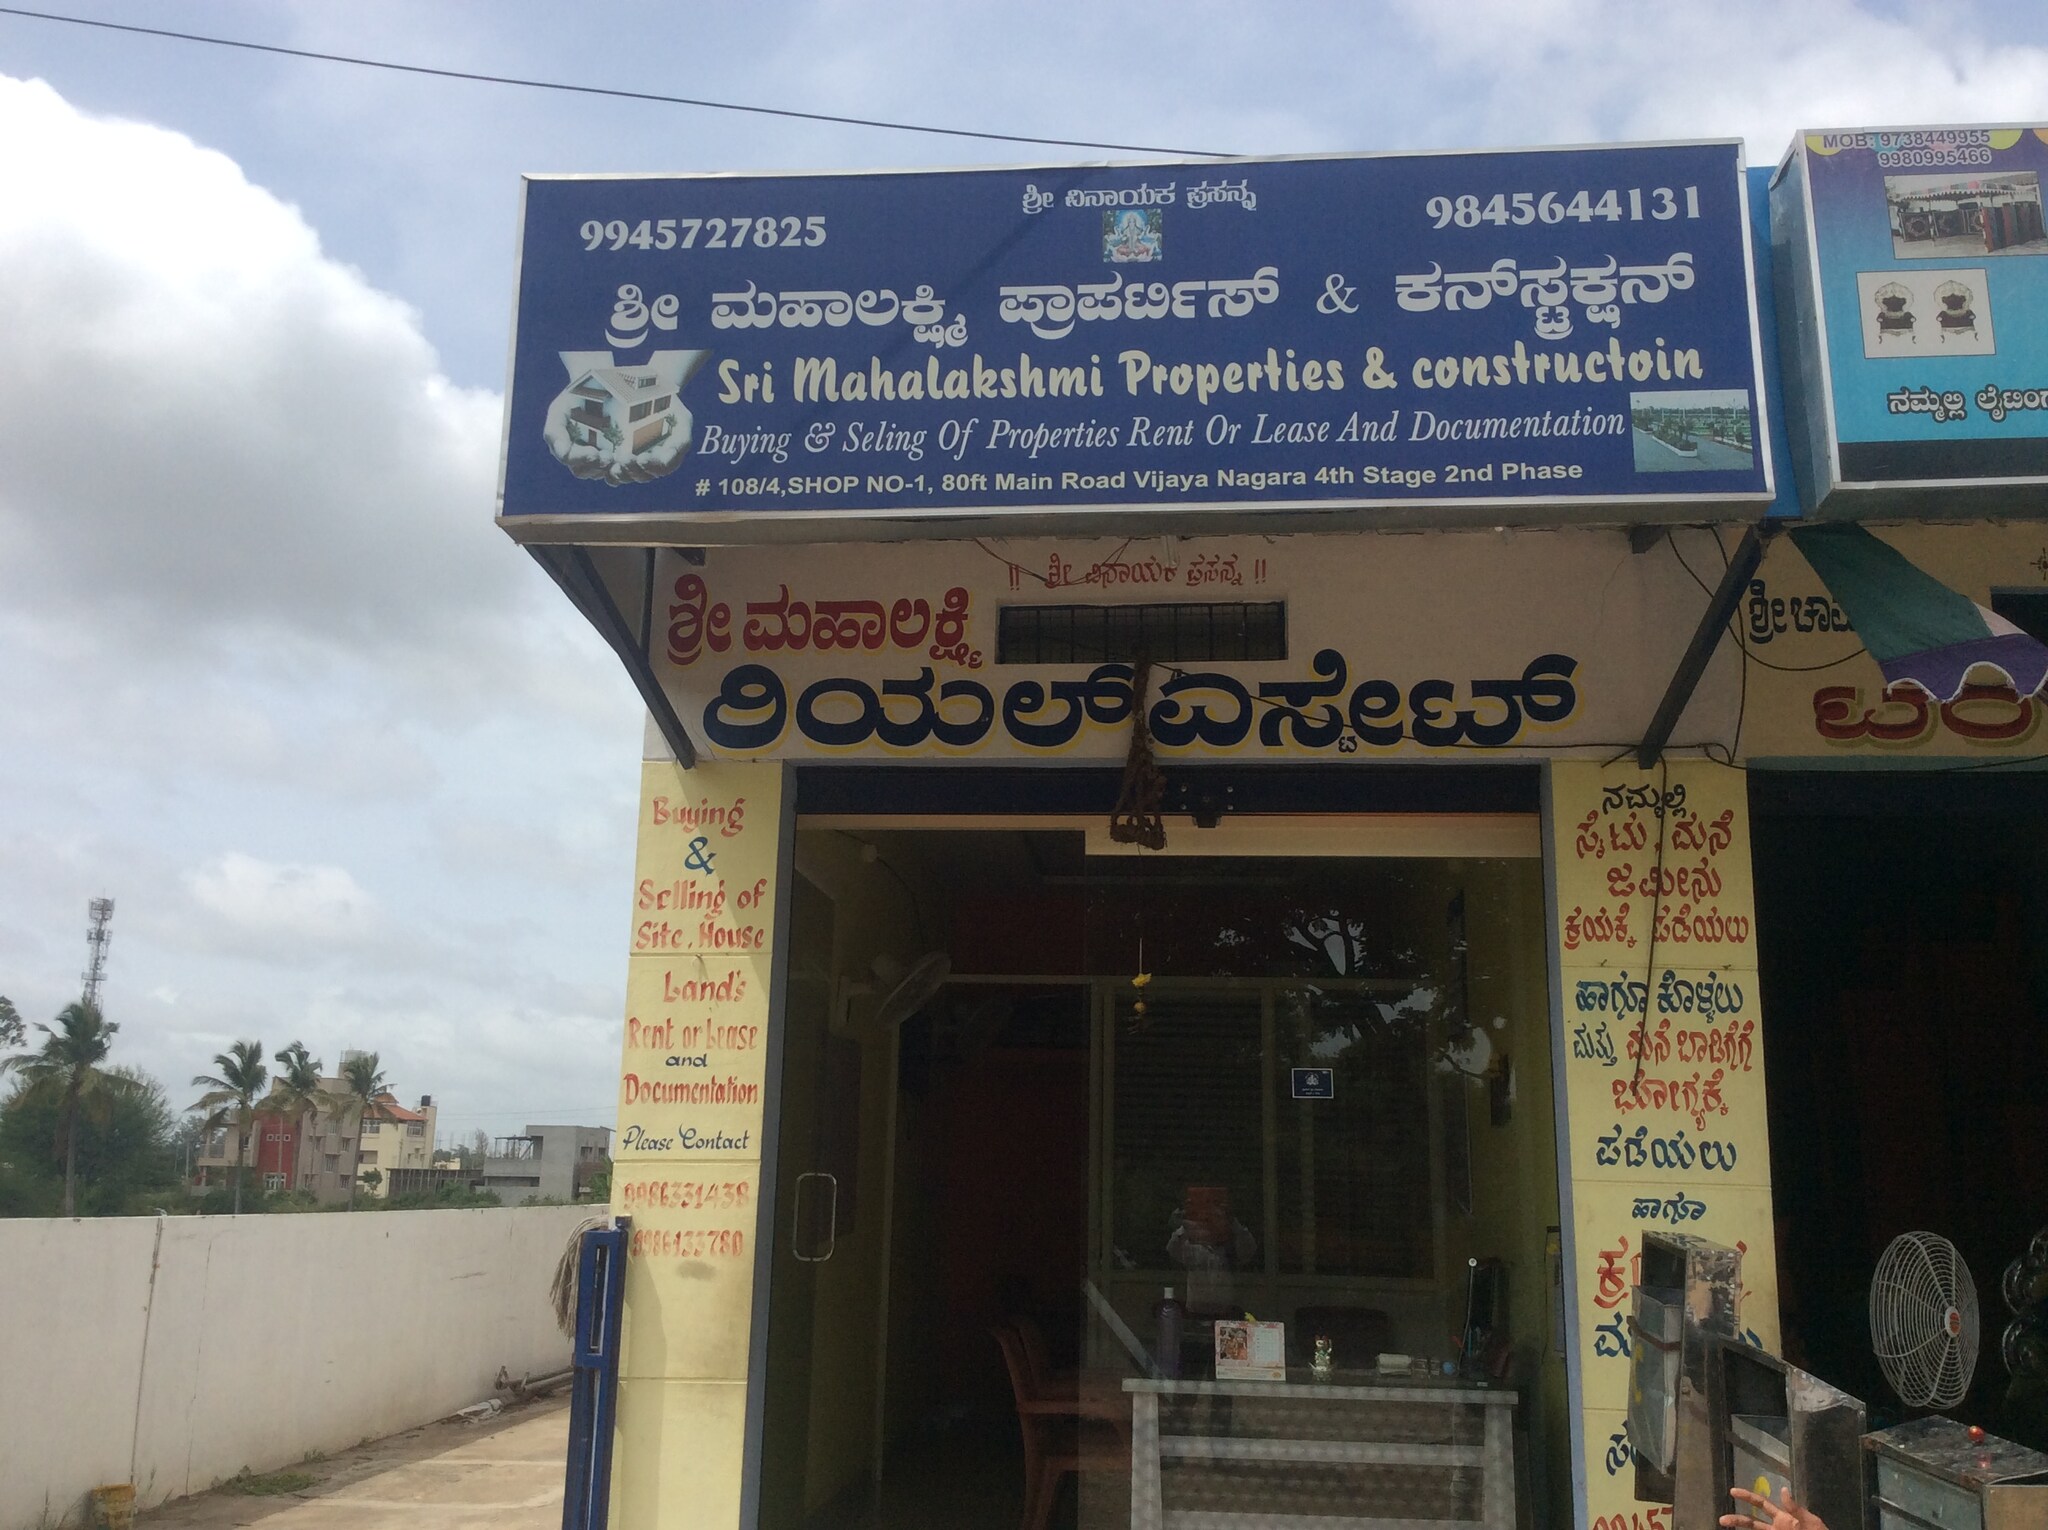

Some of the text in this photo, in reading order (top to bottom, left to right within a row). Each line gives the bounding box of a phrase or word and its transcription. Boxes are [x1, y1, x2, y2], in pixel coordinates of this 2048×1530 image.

[1822, 129, 1991, 150] MOB: 9738449955
[1878, 150, 1992, 168] 9980995466
[1022, 179, 1257, 214] ಶ್ರೀ ವಿನಾಯಕ ಪ್ರಸನ್ನ
[1426, 185, 1701, 230] 9845644131
[579, 215, 828, 251] 9945727825
[605, 284, 680, 348] ಶ್ರೀ
[710, 279, 968, 348] ಮಹಾಲಕ್ಷ್ಮಿ
[1316, 273, 1359, 314] &
[717, 337, 1703, 406] Sri Mahalakshmi Properties & constructoin
[1888, 387, 1967, 422] ನಮ್ಮಲ್ಲಿ
[697, 407, 1625, 463] Buying & Seling Of Properties Rent Or Lease And Documentation
[866, 475, 934, 495] NO-1,
[941, 473, 988, 493] 80ft
[996, 473, 1052, 491] Main
[1061, 471, 1125, 489] Road
[1134, 471, 1209, 493] Vijaya
[1217, 469, 1306, 492] Nagara
[1313, 468, 1354, 486] 4th
[1363, 467, 1436, 488] Stage
[1444, 465, 1493, 484] 2nd
[1502, 463, 1583, 482] Phase
[1186, 553, 1243, 586] ಪ್ರಸನ್ನ
[667, 573, 731, 666] ಶ್ರೀ
[703, 663, 1135, 748] ರಿಯಲ್
[652, 796, 746, 837] Buying
[1602, 784, 1686, 818] ನಮ್ಮಲ್ಲಿ
[1671, 809, 1734, 856] ಮನೆ
[684, 836, 717, 875] &
[638, 878, 768, 919] Selling of
[1607, 857, 1722, 904] ಜಮೀನು
[699, 921, 764, 949] House
[1564, 903, 1749, 950] ಕ್ರಯಕ್ಕೆ ಪಡೆಯಲು
[663, 970, 746, 1002] Land's
[1575, 970, 1743, 1023] ಹಾಗೂ ಕೊಳ್ಳಲು
[626, 1016, 758, 1050] Rent or Lease
[1573, 1018, 1754, 1071] ಮತ್ತು ಮನೆ ಬಾಡಿಗೆಗೆ
[665, 1053, 708, 1067] and
[623, 1073, 758, 1105] Documentation
[623, 1123, 750, 1150] Please Contact
[1596, 1123, 1737, 1171] ಪಡೆಯಲು
[1632, 1192, 1706, 1224] ಹಾಗೂ
